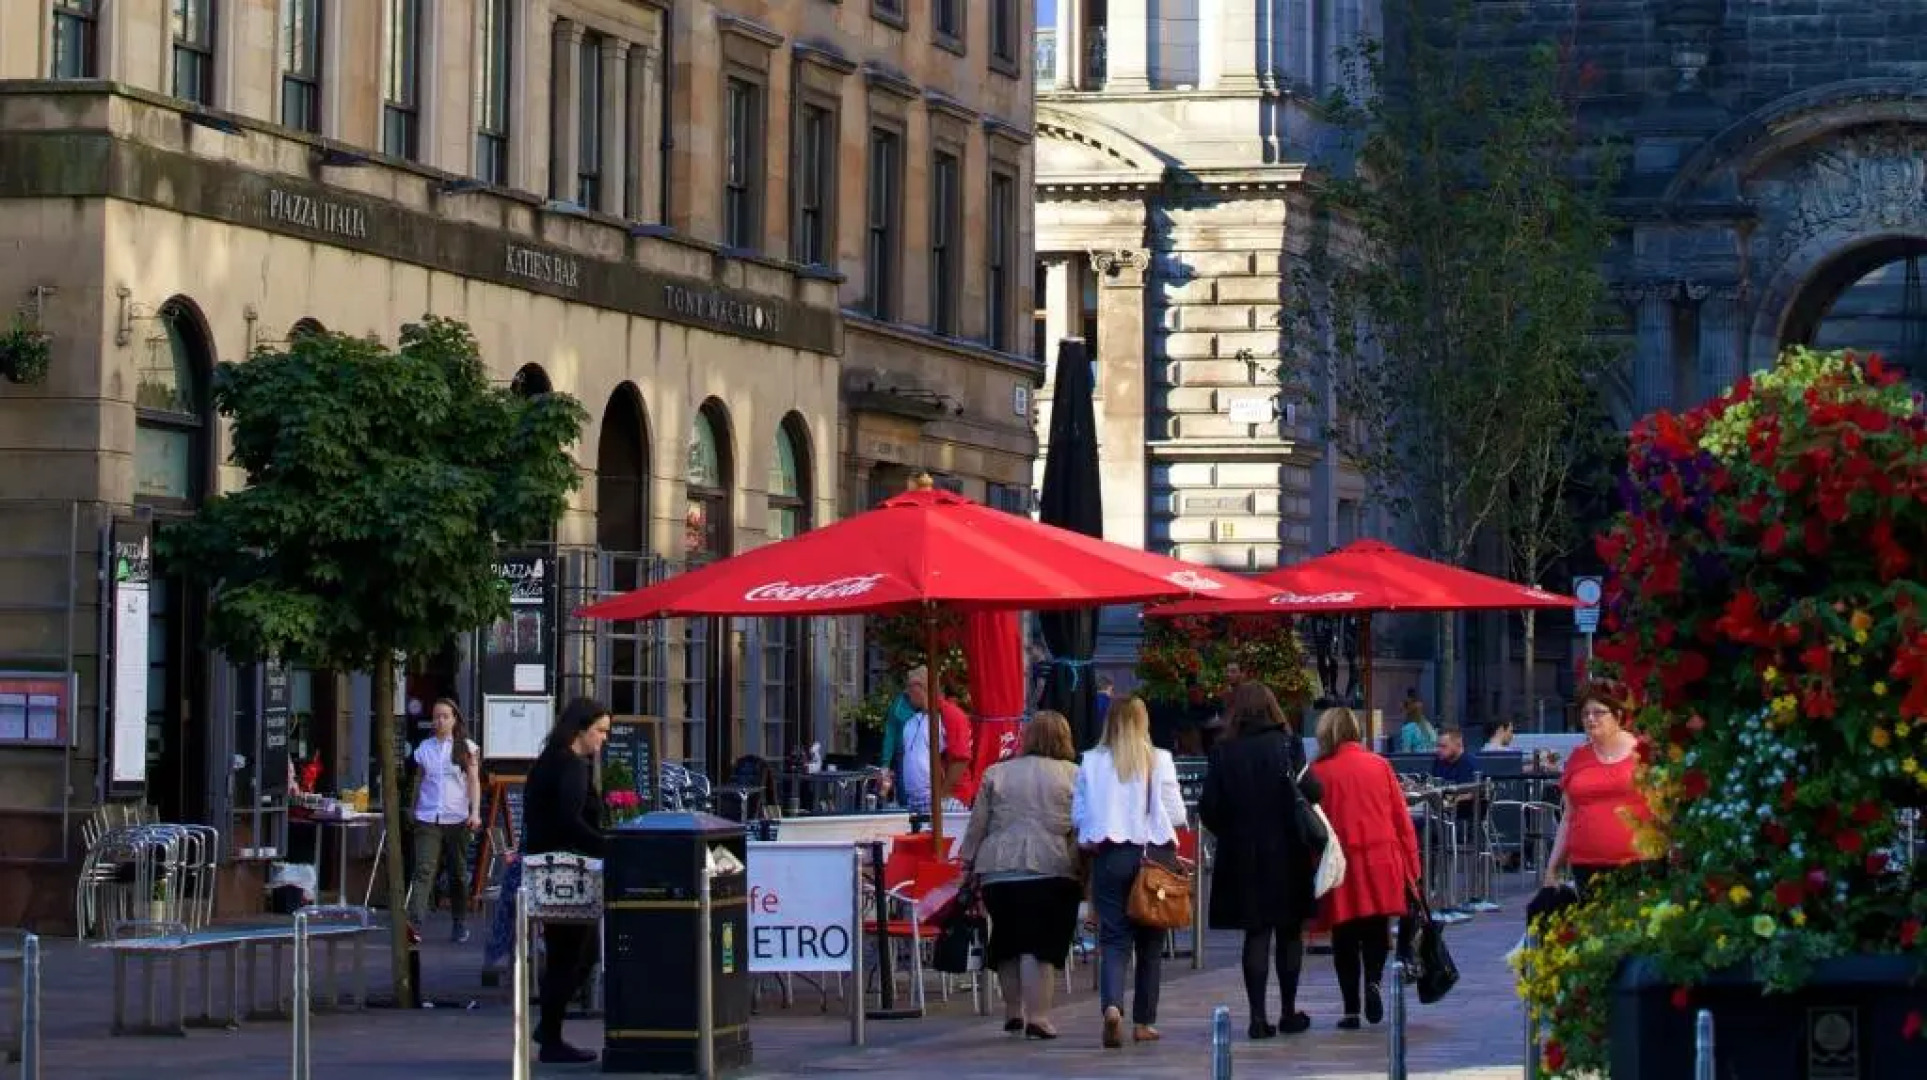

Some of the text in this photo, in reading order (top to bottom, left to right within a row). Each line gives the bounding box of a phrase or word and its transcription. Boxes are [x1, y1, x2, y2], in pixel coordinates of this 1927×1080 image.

[270, 189, 366, 238] PIAZZA ITALIA
[506, 246, 577, 287] KATIE'S BAR
[664, 285, 703, 318] TONY
[490, 563, 535, 579] PIAZZA
[745, 573, 885, 601] Coca-Cola
[751, 886, 779, 914] fe
[753, 925, 850, 959] ETRO
